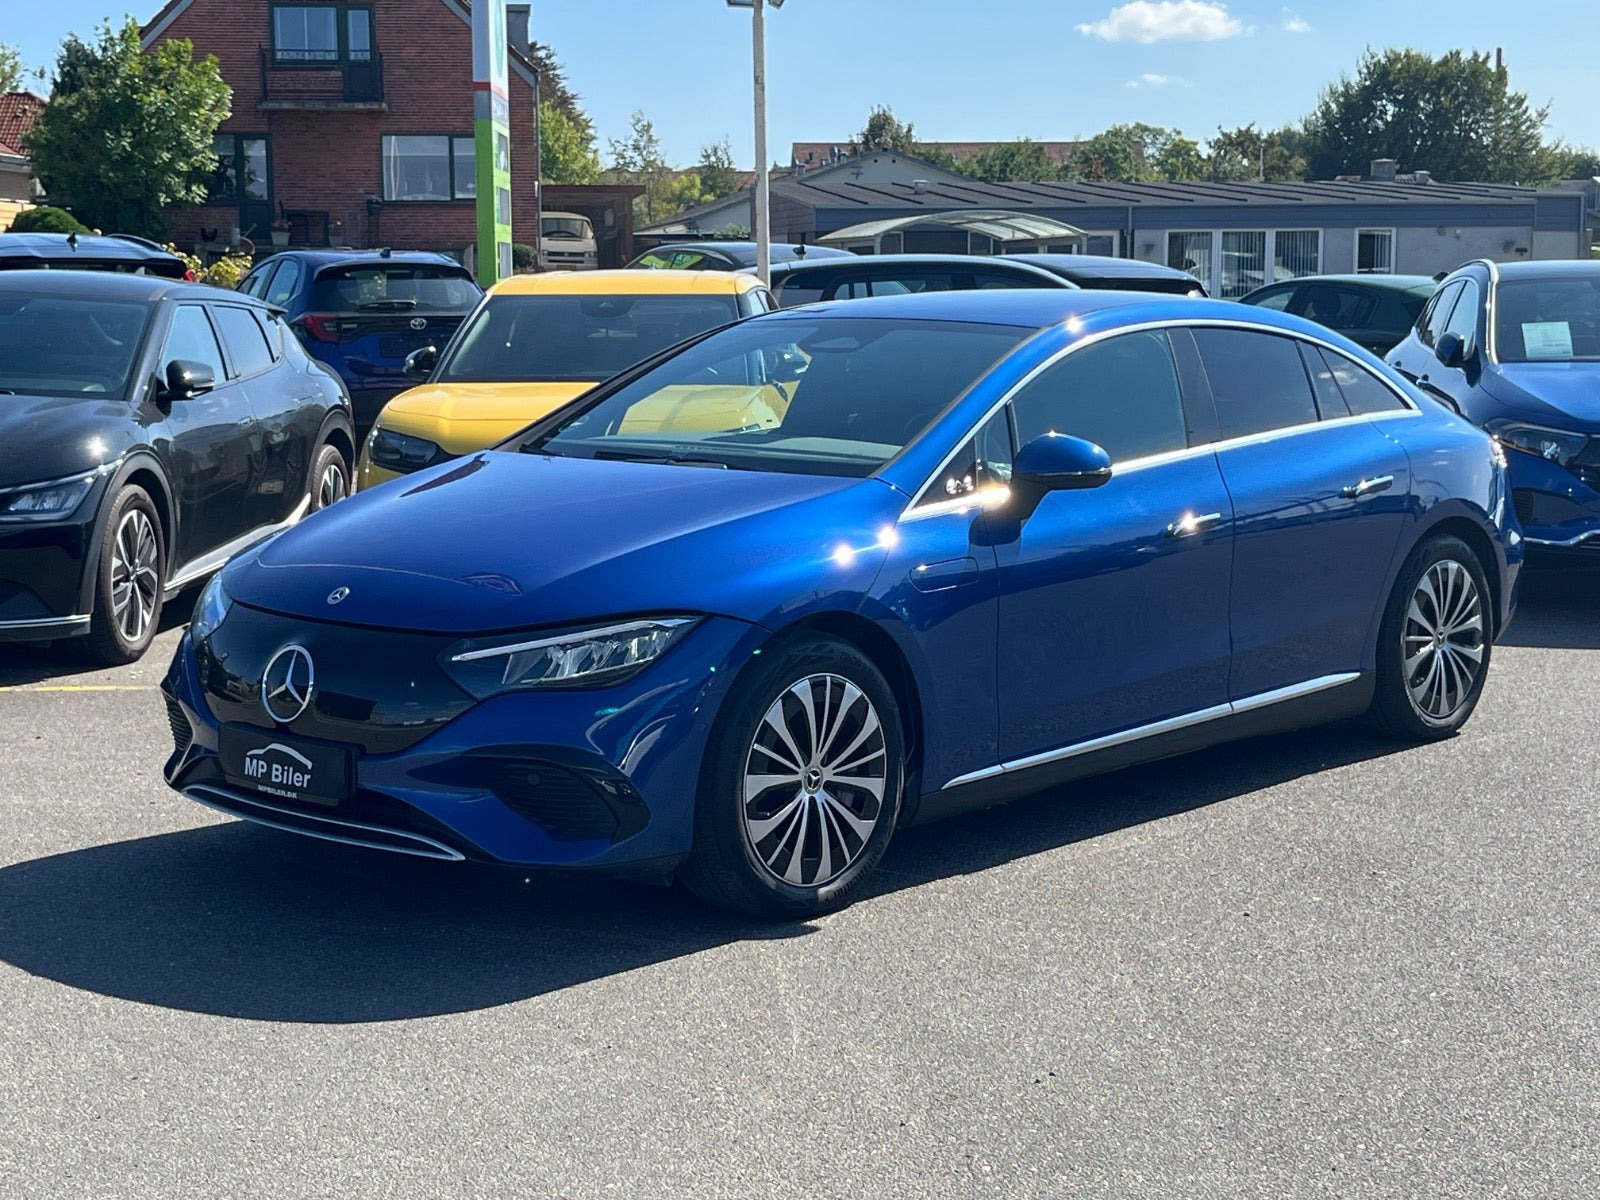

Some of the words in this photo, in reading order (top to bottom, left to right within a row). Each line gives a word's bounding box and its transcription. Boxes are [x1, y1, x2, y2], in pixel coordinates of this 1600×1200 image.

[244, 756, 267, 778] MP
[271, 763, 311, 788] Biler
[257, 784, 298, 799] MPBILER.DK
